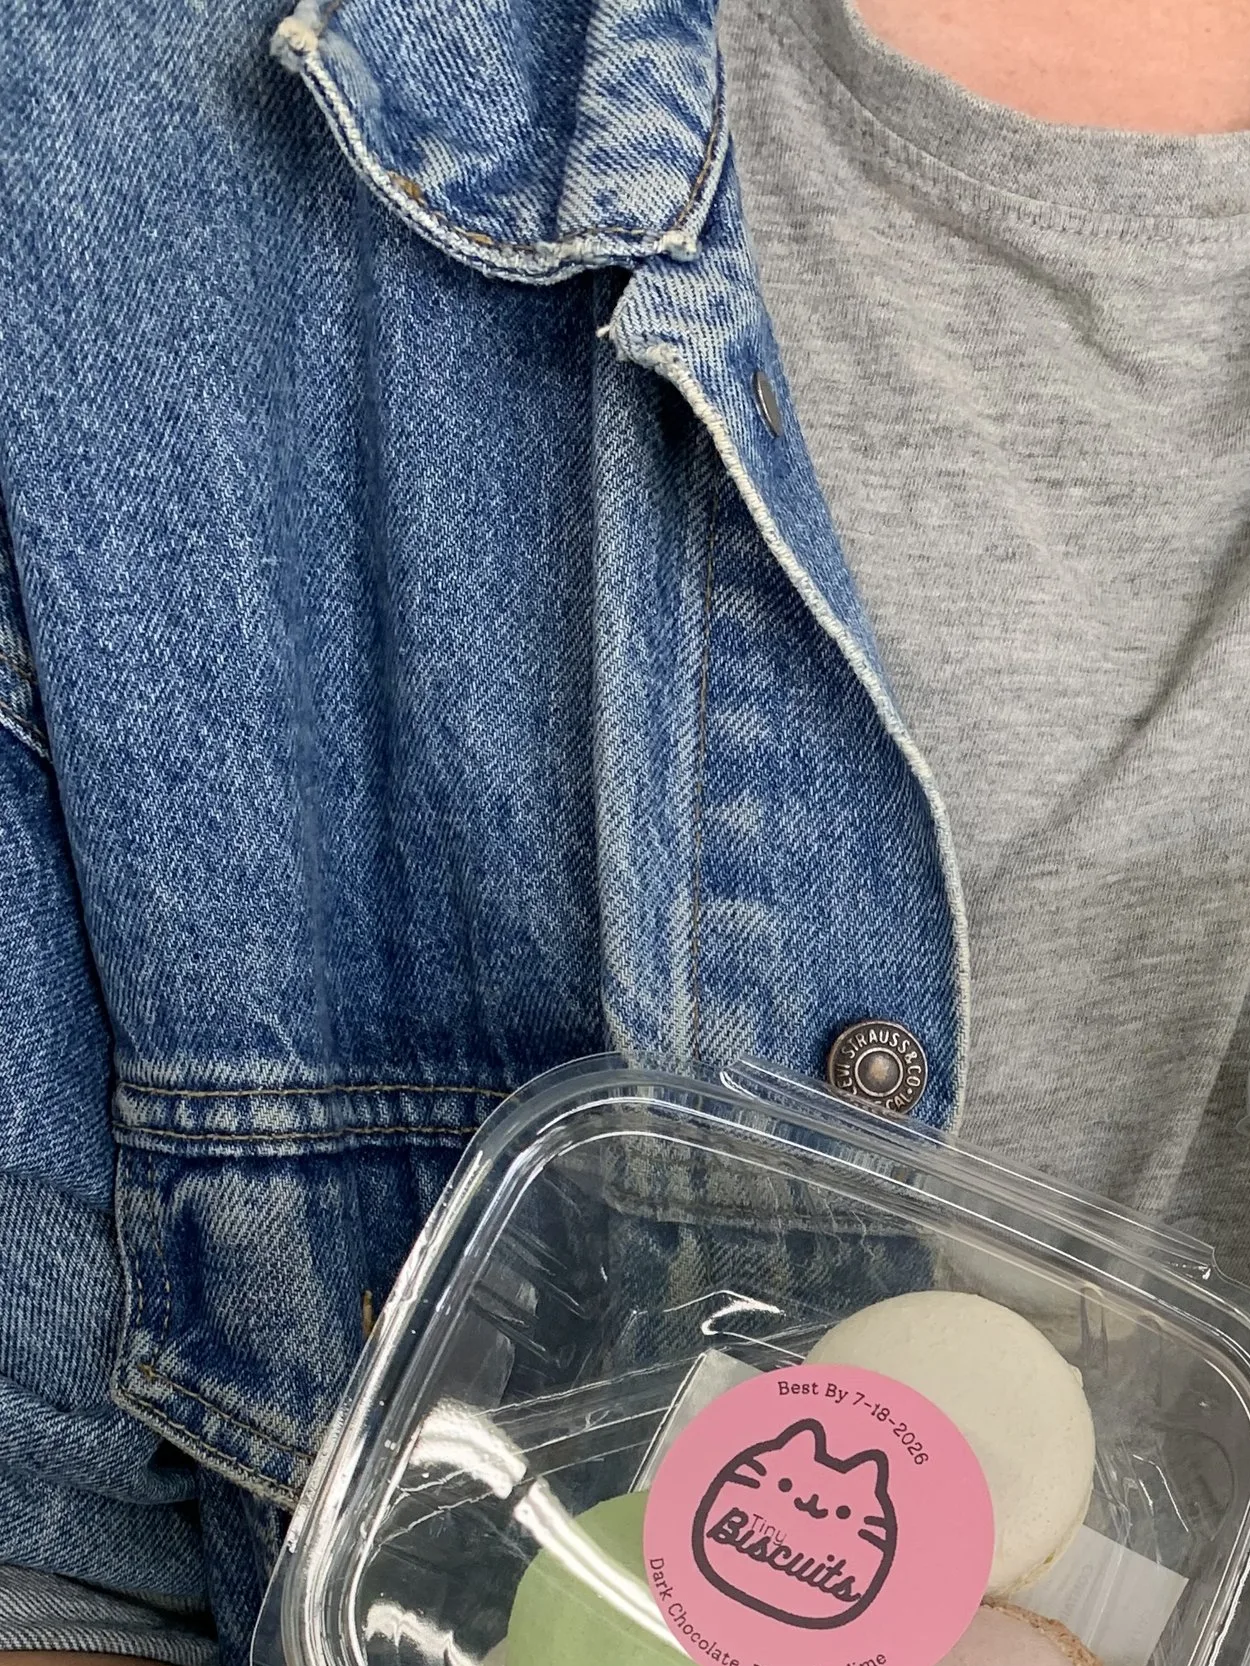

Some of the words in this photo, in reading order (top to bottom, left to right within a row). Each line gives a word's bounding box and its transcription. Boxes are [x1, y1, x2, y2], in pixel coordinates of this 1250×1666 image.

[841, 1028, 911, 1059] STRAUSS
[904, 1051, 918, 1064] &
[777, 1380, 819, 1396] Best
[824, 1383, 850, 1404] By
[851, 1392, 930, 1466] 7-18-2026
[750, 1513, 788, 1543] Tiny
[706, 1507, 863, 1602] Biscuits
[650, 1557, 673, 1601] Dark
